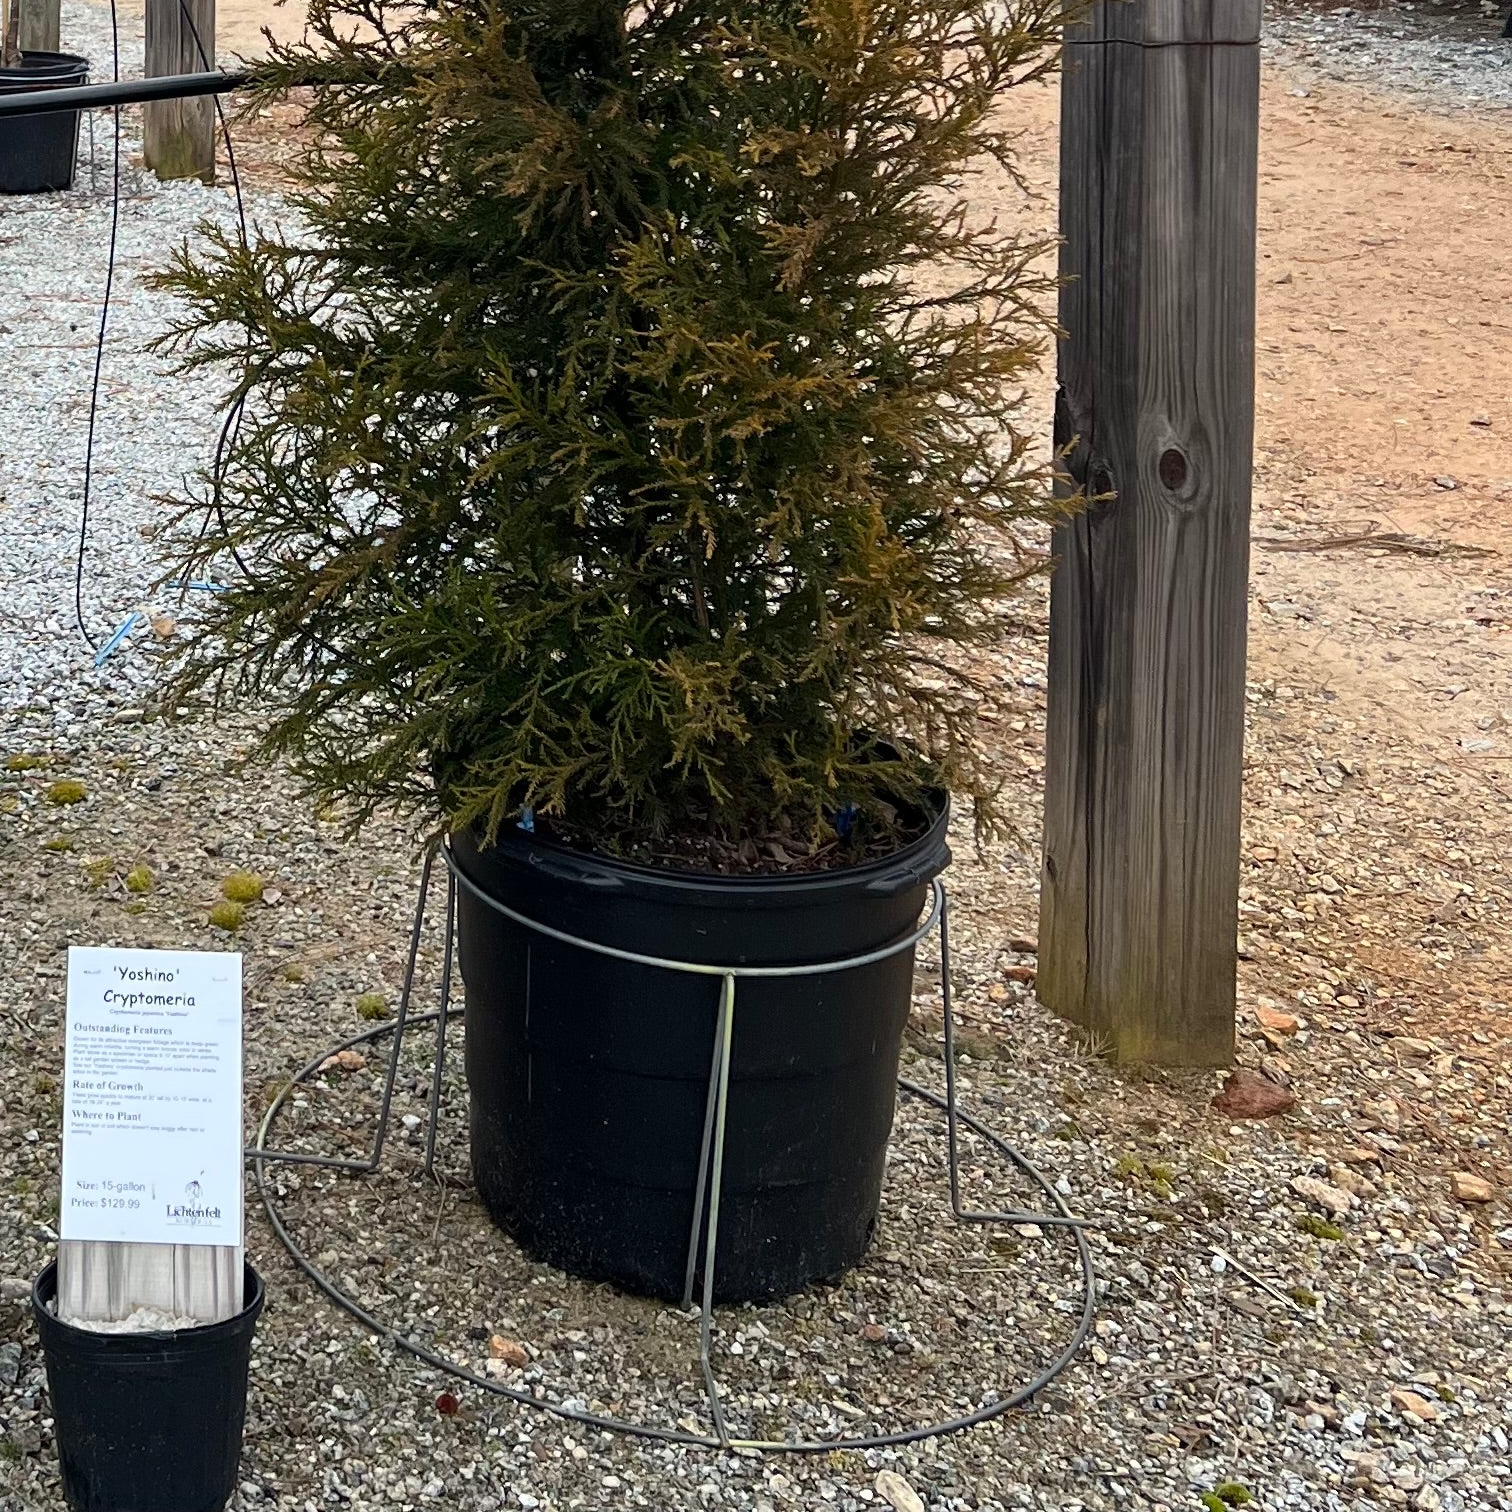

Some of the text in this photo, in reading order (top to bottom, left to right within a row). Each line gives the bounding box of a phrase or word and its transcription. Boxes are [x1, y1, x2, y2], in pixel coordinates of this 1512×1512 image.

[113, 965, 180, 983] 'Yoshino'
[103, 989, 196, 1008] Cryptomeria
[74, 1022, 173, 1035] Outstanding Features
[72, 1079, 144, 1092] Rate of Growth
[72, 1109, 142, 1122] Where to Plant
[76, 1180, 146, 1193] Size: 15-gallon
[71, 1196, 98, 1208] Price:
